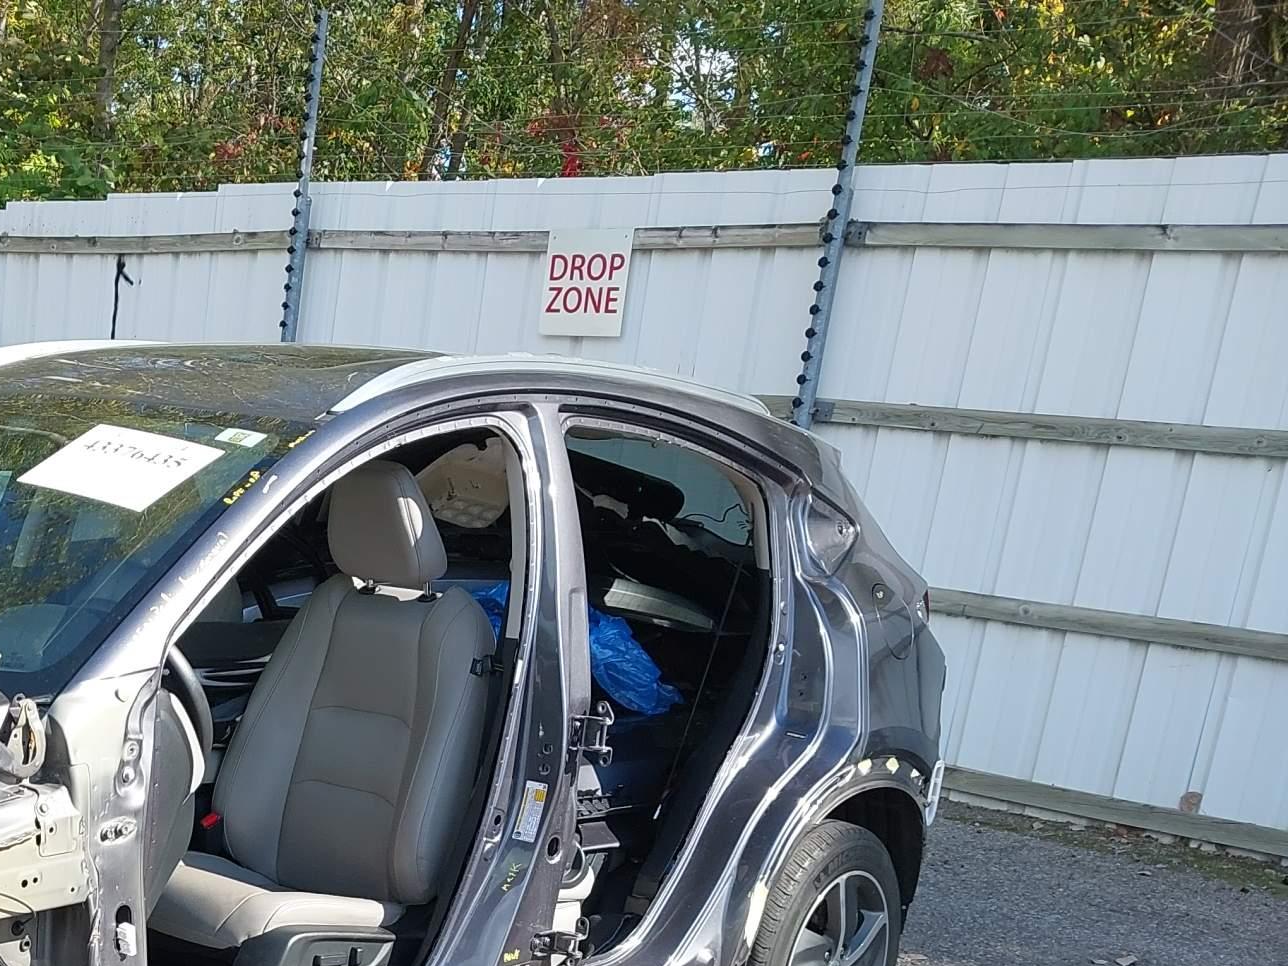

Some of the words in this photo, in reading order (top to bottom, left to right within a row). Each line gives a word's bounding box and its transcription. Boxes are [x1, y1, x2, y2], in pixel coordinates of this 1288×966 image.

[549, 253, 626, 281] DROP
[545, 286, 620, 314] ZONE
[83, 440, 188, 469] 43376435
